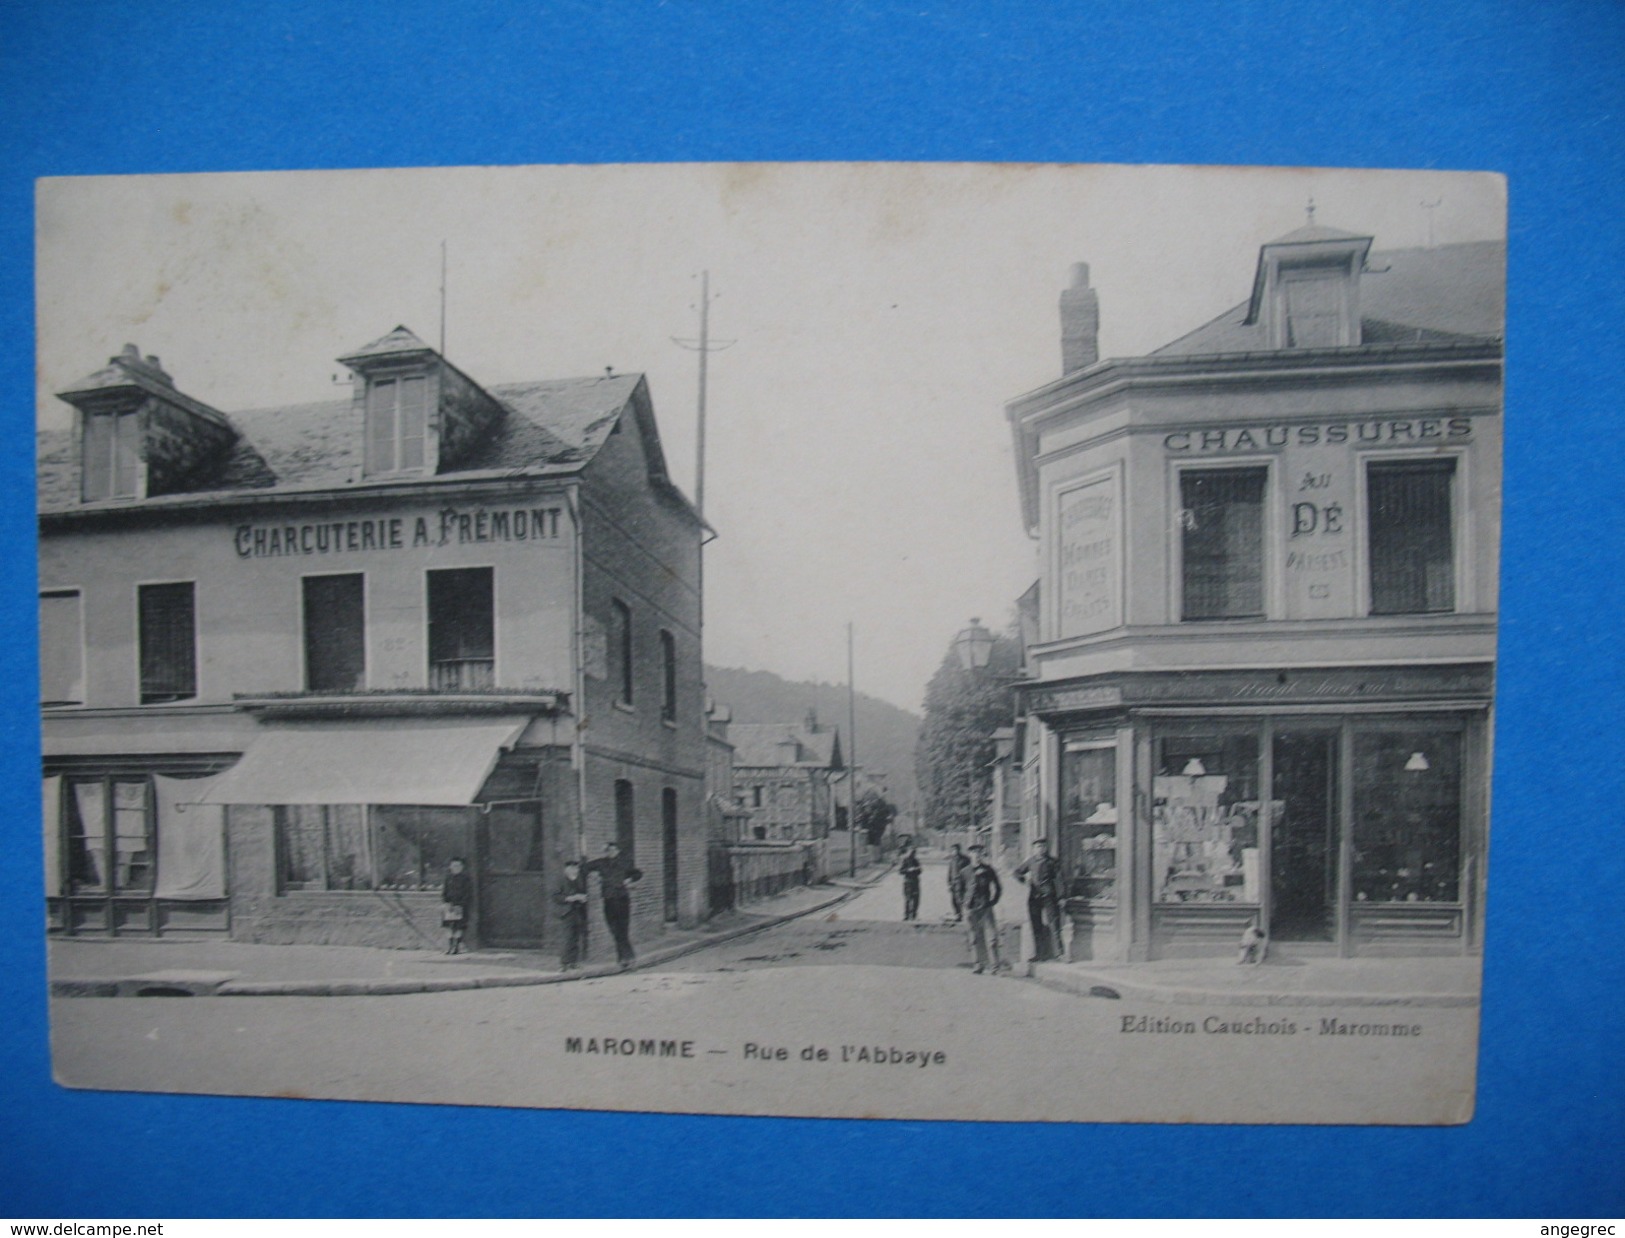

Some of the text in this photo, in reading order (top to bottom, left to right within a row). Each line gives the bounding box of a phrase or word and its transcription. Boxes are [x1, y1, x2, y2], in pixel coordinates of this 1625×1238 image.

[1163, 418, 1474, 451] CHAUSSURES
[234, 506, 562, 559] CHARCUTERIE A. FRÉMONT
[1290, 501, 1343, 538] DÉ
